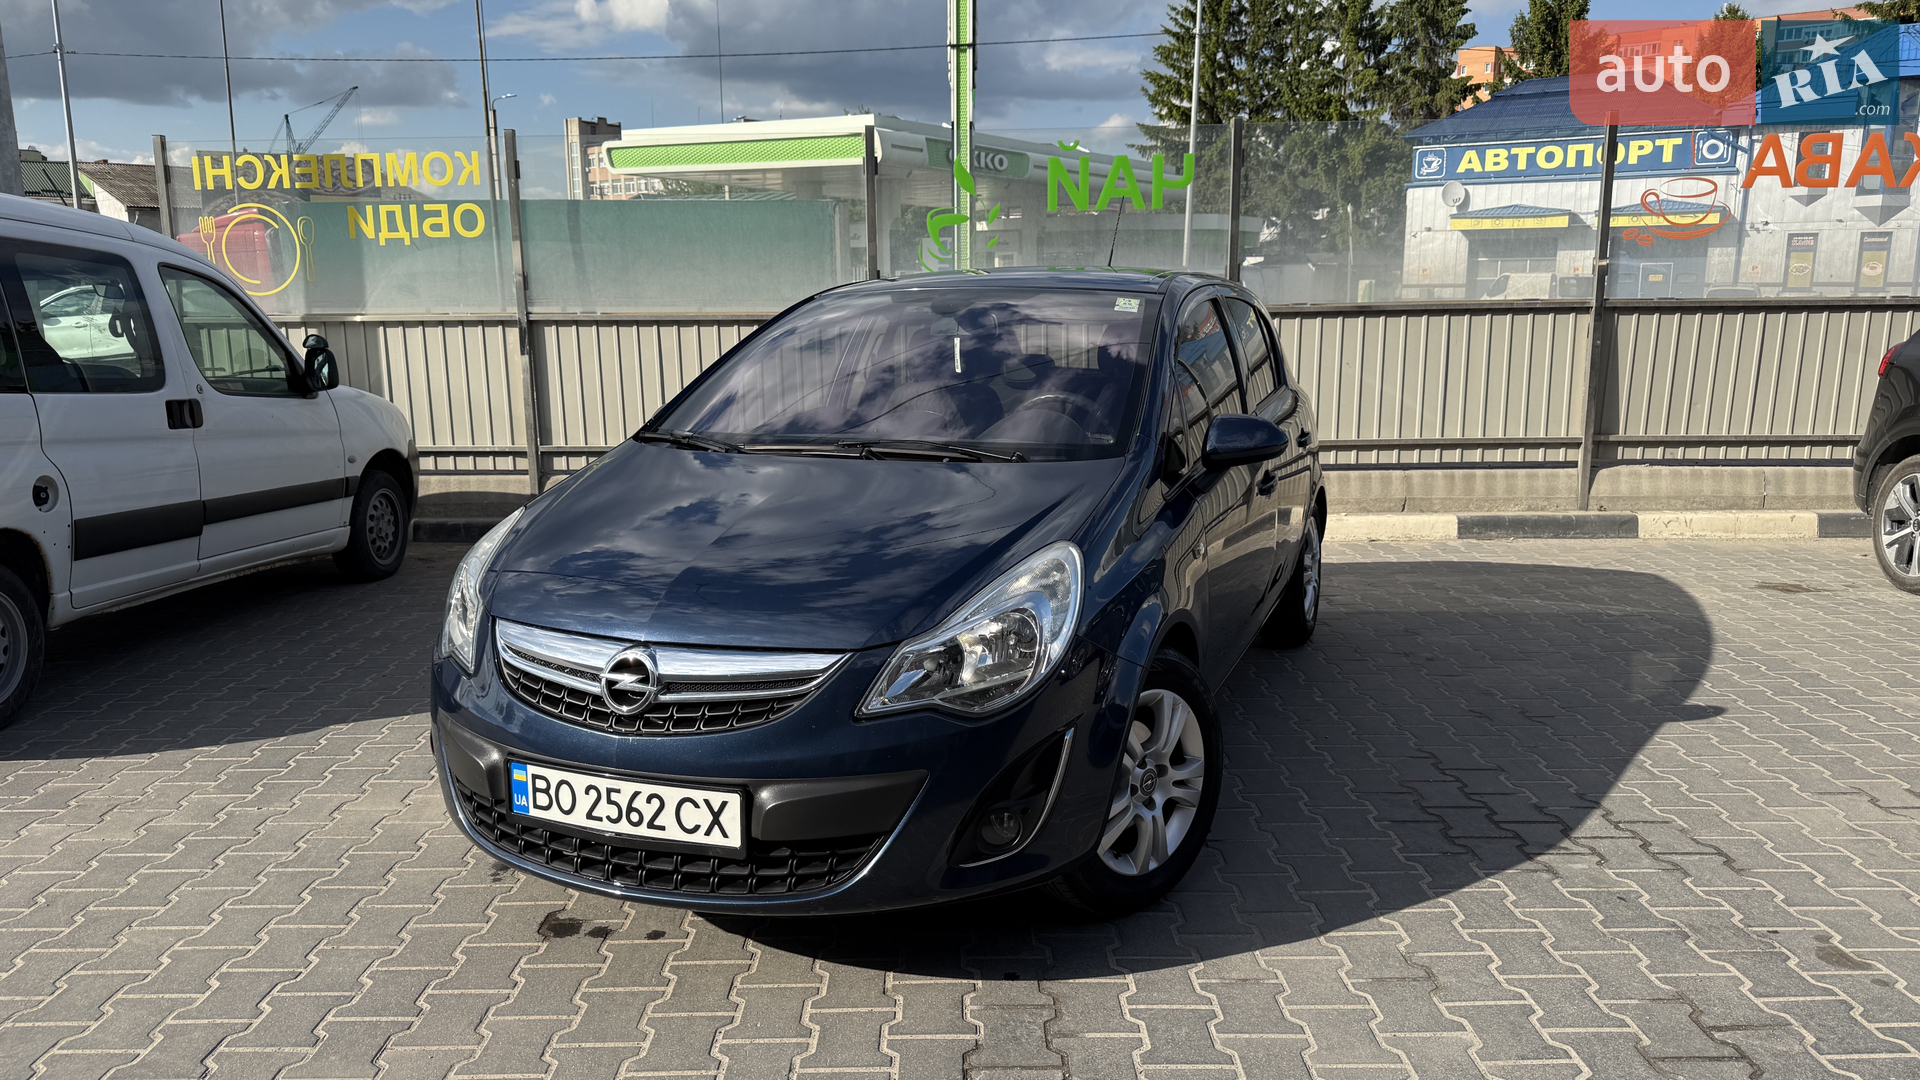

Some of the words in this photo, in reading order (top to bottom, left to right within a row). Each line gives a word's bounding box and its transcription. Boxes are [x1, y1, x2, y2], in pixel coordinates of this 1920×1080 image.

[1456, 137, 1683, 174] АВТОПОРТ
[514, 793, 528, 807] UA
[531, 773, 577, 816] BO
[584, 784, 666, 832] 2562
[674, 796, 730, 839] CX
